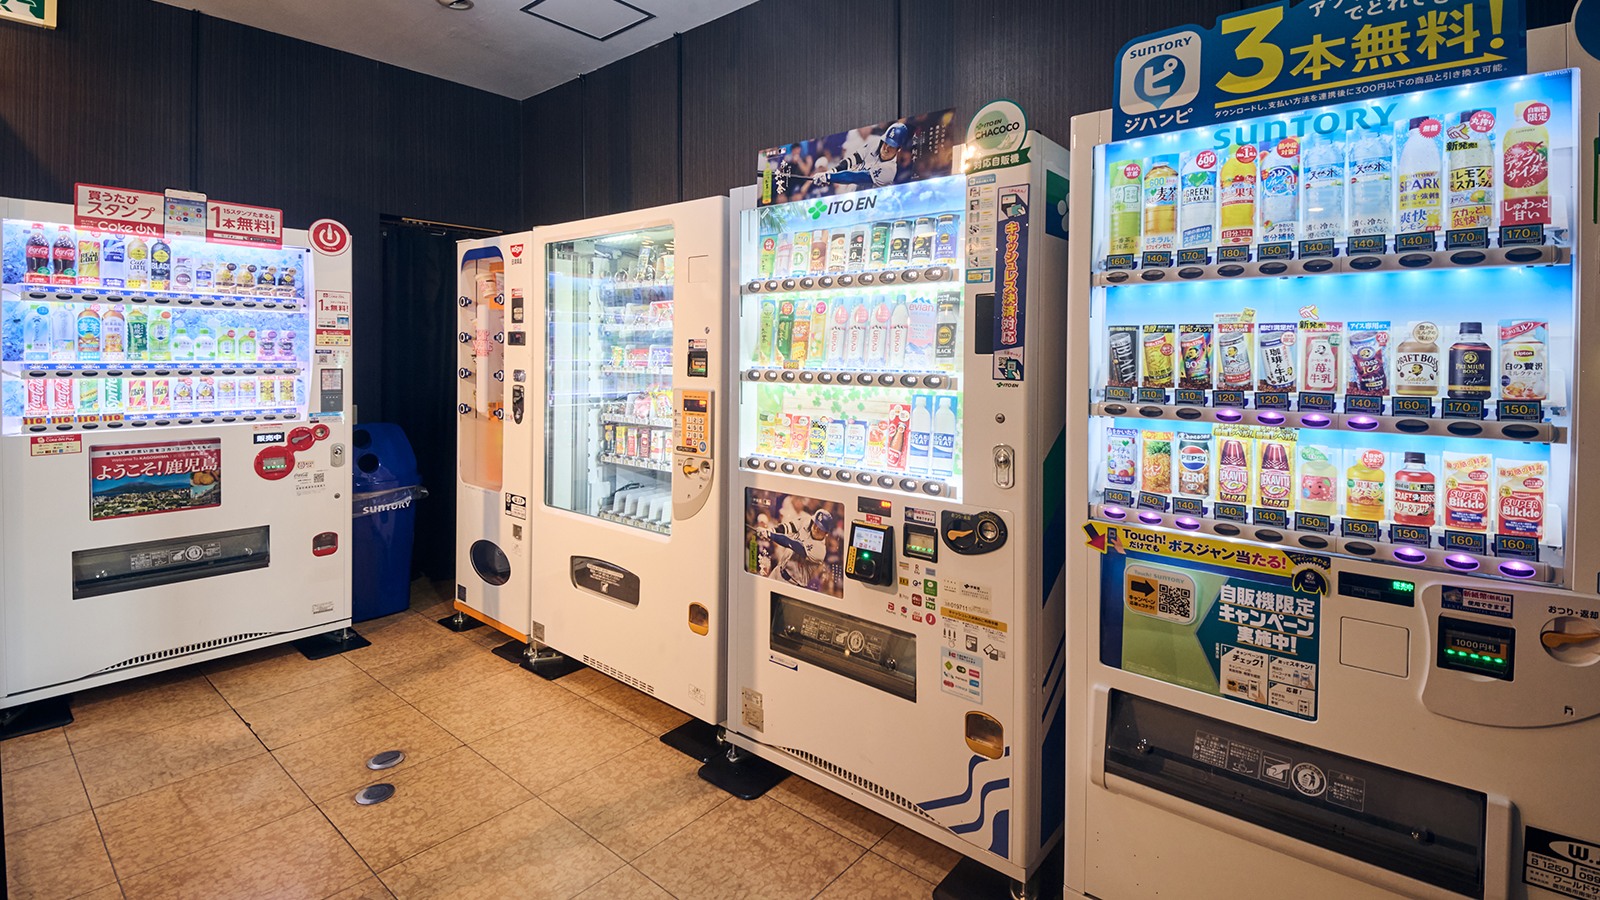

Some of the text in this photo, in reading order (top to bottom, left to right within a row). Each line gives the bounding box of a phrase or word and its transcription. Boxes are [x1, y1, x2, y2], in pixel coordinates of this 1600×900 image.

[1130, 36, 1192, 59] SUNTORY
[1144, 58, 1178, 96] ピ
[1125, 107, 1193, 133] ジハンピ
[1527, 112, 1548, 122] 限定
[975, 122, 1020, 140] CHACOCO
[1213, 103, 1398, 150] SUNTORY
[973, 153, 1020, 170] 対応自販機
[1198, 156, 1215, 165] 600
[1506, 152, 1545, 170] アップル
[1456, 168, 1485, 179] レモン
[1507, 163, 1548, 181] サイダー
[1400, 178, 1439, 193] SPARK
[88, 189, 140, 205] 買うたび
[1157, 187, 1178, 201] 麦茶
[1186, 188, 1209, 197] GREEN
[87, 201, 156, 220] スタンプ
[828, 195, 878, 215] ITO EN
[1505, 199, 1548, 211] しゅわっと
[223, 208, 275, 220] 15スタンプたまると
[1400, 209, 1427, 223] 爽快
[1513, 209, 1540, 221] 甘い
[211, 206, 276, 235] 1本無料!
[1453, 214, 1480, 227] 爽快!
[97, 221, 134, 234] Coke
[1400, 221, 1426, 232] レモン
[1452, 232, 1483, 243] 170円
[1506, 228, 1539, 239] 170円
[1353, 239, 1381, 248] 140円
[1401, 236, 1431, 245] 140円
[28, 246, 49, 256] Coca-Cola
[55, 247, 75, 257] Coca-Cola
[1262, 246, 1288, 255] 150円
[1303, 242, 1330, 252] 140円
[1147, 254, 1168, 262] 140円
[1181, 251, 1204, 260] 170円
[1222, 249, 1245, 257] 180円
[80, 256, 99, 264] GOLD
[1110, 257, 1130, 265] 160円
[1002, 221, 1019, 345] キャッシュレス決済対応
[908, 303, 936, 312] evian.
[1377, 333, 1388, 341] 20
[1360, 359, 1379, 367] BOSS
[1396, 354, 1439, 373] CRAFT BOSS
[1455, 363, 1485, 371] PREMIUM
[1505, 362, 1543, 371] 白の贅沢
[1310, 374, 1333, 384] 牛乳
[1180, 392, 1201, 400] 110円
[1218, 394, 1240, 402] 120円
[1260, 396, 1285, 404] 120円
[1304, 397, 1330, 405] 140円
[1351, 399, 1378, 408] 140円
[1398, 401, 1427, 410] 160円
[1448, 403, 1478, 413] 170円
[1504, 405, 1536, 415] 150円
[256, 434, 282, 442] 販売中
[1181, 455, 1207, 463] PEPSI
[96, 456, 218, 481] ようこそ!鹿児島
[1182, 472, 1205, 483] ZERO
[1225, 481, 1242, 490] C
[1268, 485, 1284, 495] C
[1108, 493, 1128, 501] 140円
[1143, 496, 1162, 505] 150円
[1395, 492, 1436, 503] CRAFT BOSS
[1450, 490, 1484, 500] SUPER
[362, 499, 412, 515] SUNTORY
[1177, 501, 1199, 510] 140円
[1449, 499, 1485, 509] Bikkle
[1503, 497, 1539, 509] SUPER
[1219, 506, 1242, 516] 140円
[1258, 511, 1282, 521] 140円
[1502, 505, 1540, 518] Bikkle
[1301, 516, 1326, 528] 150円
[1348, 522, 1374, 534] 150円
[1122, 528, 1166, 545] Touch!
[1397, 529, 1425, 540] 150円
[1129, 541, 1160, 553] だけでも
[1450, 536, 1481, 547] 160円
[1501, 540, 1533, 551] 160円
[1168, 540, 1287, 570] ボスジャン当たる!
[1134, 569, 1185, 584] Touch! SUNTORY
[1392, 580, 1414, 592] 販売中
[1128, 594, 1156, 605] キャンペーン
[1220, 584, 1315, 618] 自販機限定
[1463, 590, 1510, 603] 新紙幣(新札)は
[1467, 599, 1509, 612] 使用できます。
[1548, 606, 1599, 620] おつり・返却
[1219, 604, 1315, 637] キャンペーン
[1237, 625, 1298, 653] 実施中!
[1455, 638, 1497, 652] 1000円札
[1232, 654, 1264, 668] チェック!
[1531, 858, 1539, 866] B
[1543, 861, 1569, 874] 1250
